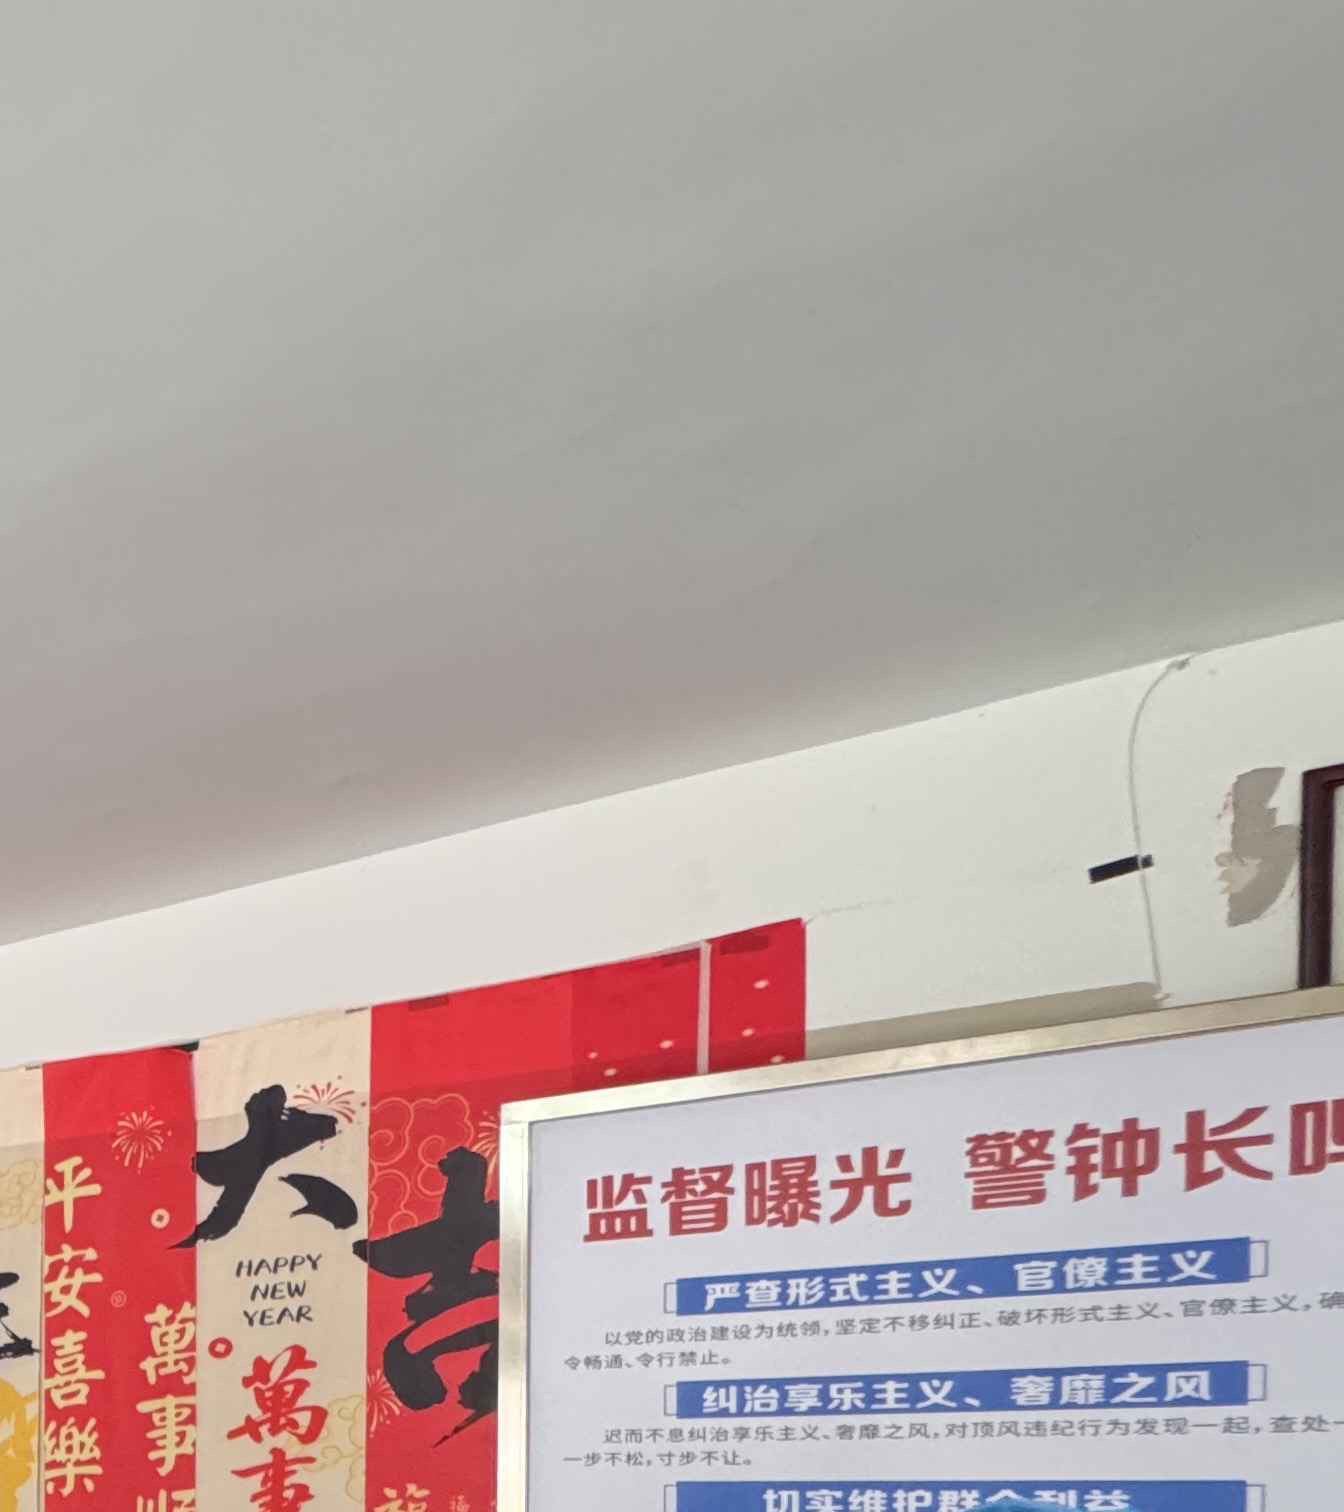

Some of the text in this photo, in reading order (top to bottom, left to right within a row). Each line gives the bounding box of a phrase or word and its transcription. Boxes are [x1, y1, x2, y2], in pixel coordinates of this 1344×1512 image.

[169, 1084, 357, 1249] 大
[582, 1144, 913, 1243] 监督曝光
[235, 1253, 323, 1278] HAPPY
[250, 1281, 307, 1301] NEW
[703, 1249, 1218, 1312] 严查形式主义、官僚主义
[44, 1156, 106, 1496] 平安喜樂
[242, 1304, 314, 1327] YEAR
[701, 1369, 1213, 1415] 纠治享乐主义、奢靡之风
